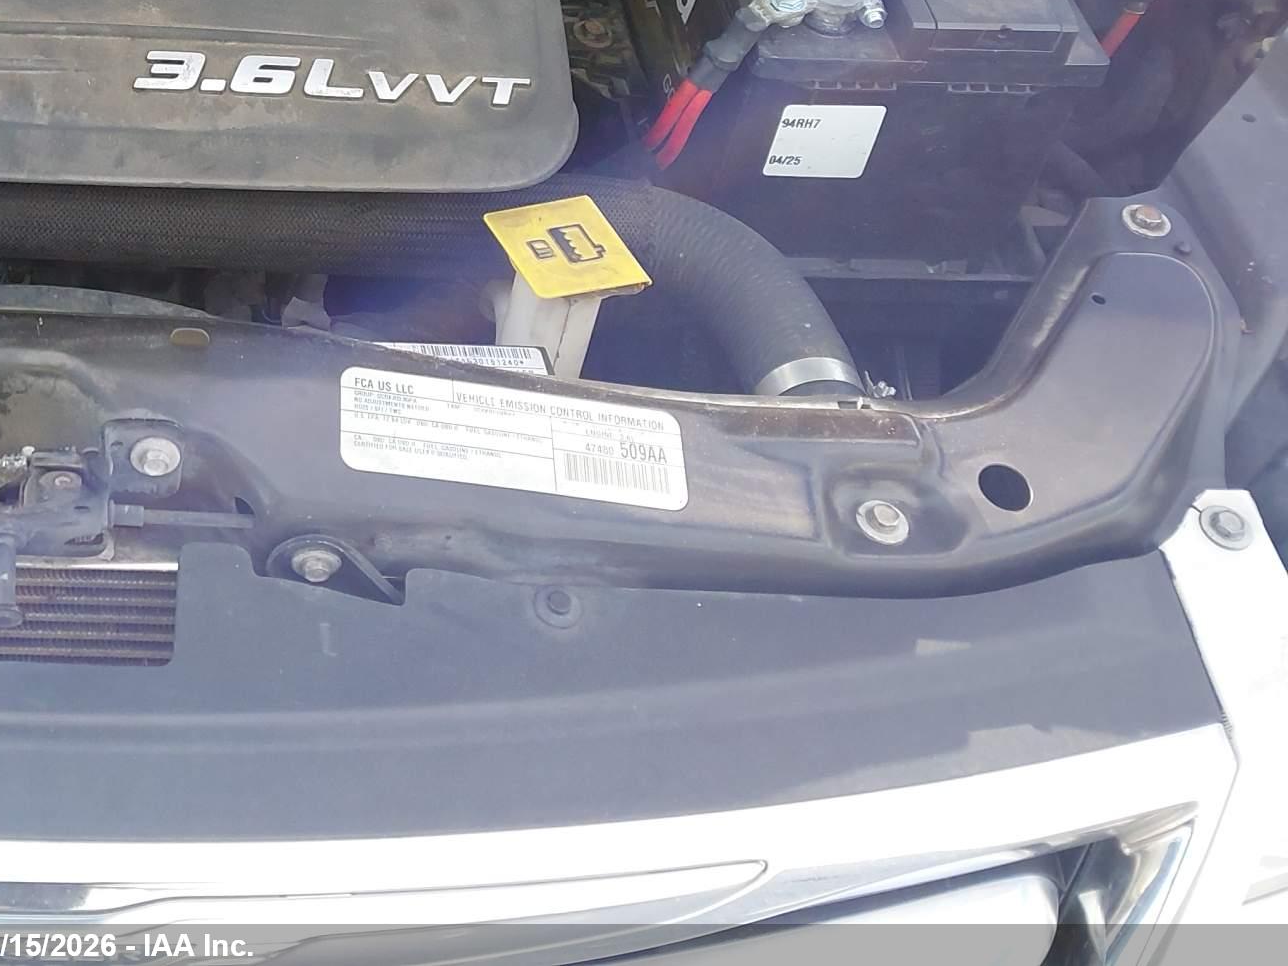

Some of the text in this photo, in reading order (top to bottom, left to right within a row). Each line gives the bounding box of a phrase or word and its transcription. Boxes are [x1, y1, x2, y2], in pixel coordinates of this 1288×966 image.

[133, 50, 532, 107] 3.6L VVT
[781, 117, 822, 129] 94RH7
[769, 155, 802, 166] 04/25
[355, 377, 374, 390] FCA
[378, 379, 392, 392] US
[396, 382, 415, 395] LLC
[457, 392, 496, 408] VEHICLE
[500, 398, 546, 415] EMISSION
[551, 406, 594, 422] CONTROL
[598, 413, 665, 431] INFORMATION
[620, 442, 668, 463] 509AA
